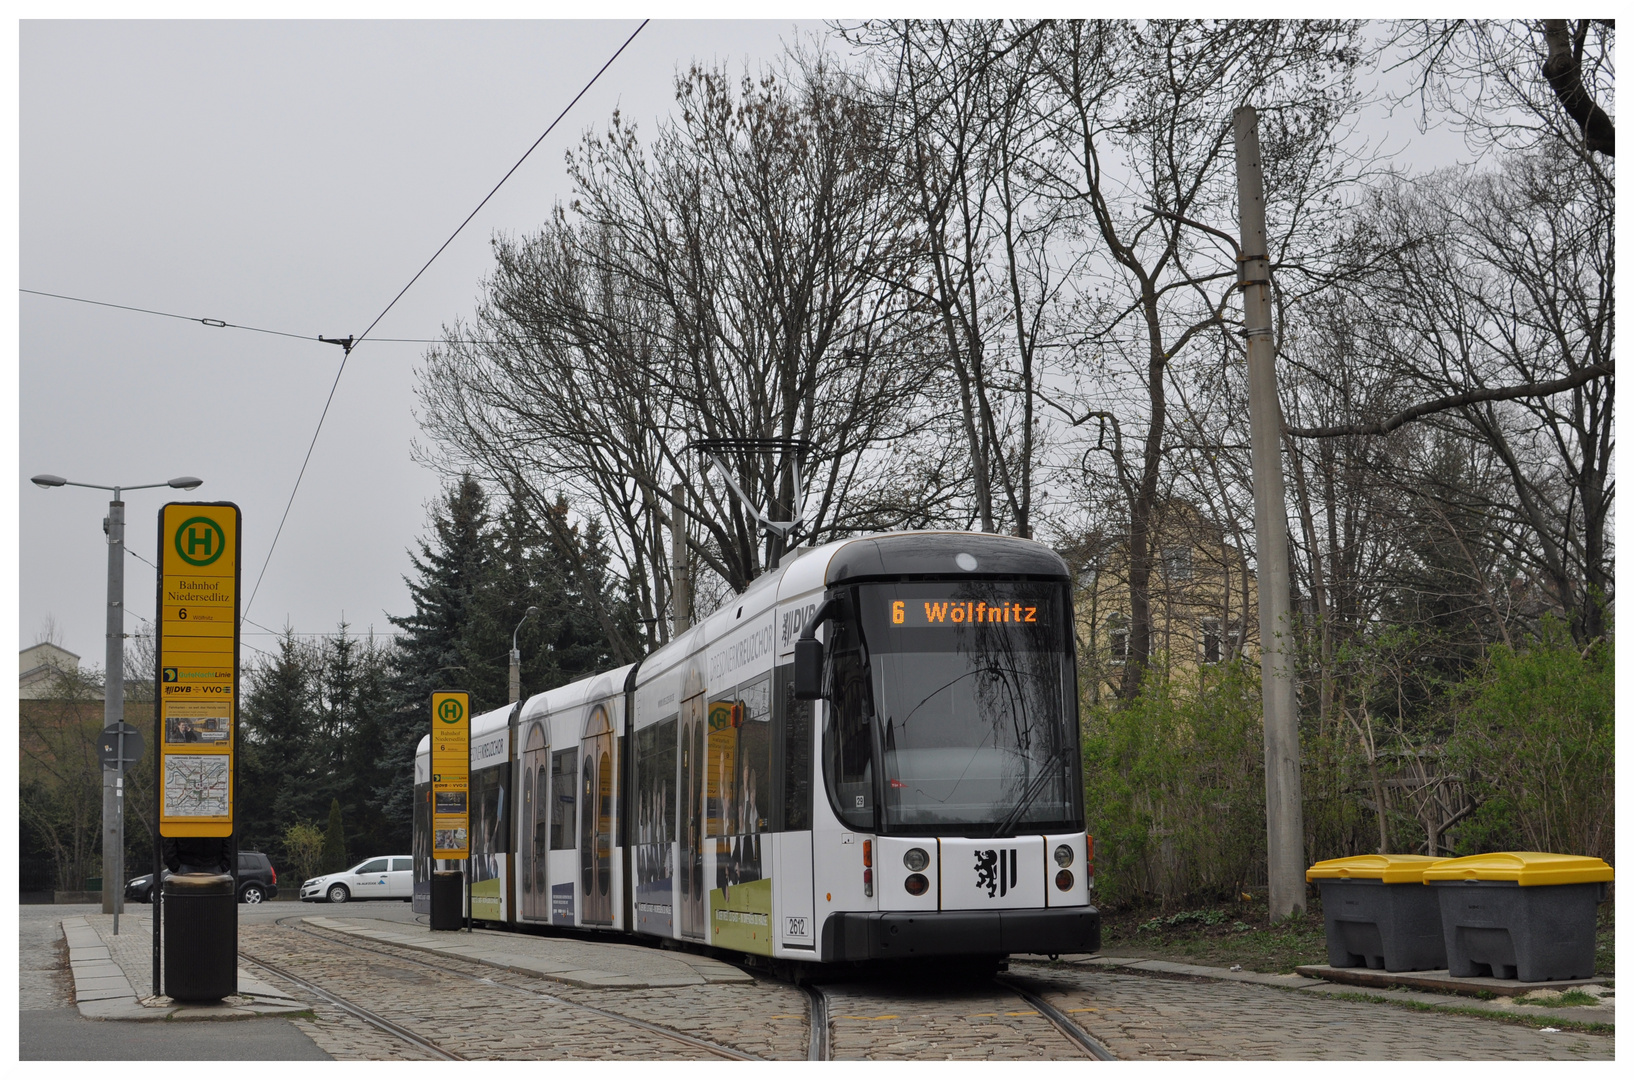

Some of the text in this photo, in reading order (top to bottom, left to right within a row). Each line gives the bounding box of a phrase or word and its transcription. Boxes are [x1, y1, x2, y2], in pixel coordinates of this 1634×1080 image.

[188, 528, 212, 555] H
[179, 580, 220, 591] Bahnhof
[168, 591, 230, 602] Niedersedlitz
[178, 608, 188, 620] 6
[892, 600, 1037, 624] 6 Wölfnitz
[444, 704, 457, 718] H
[789, 918, 805, 935] 2612
